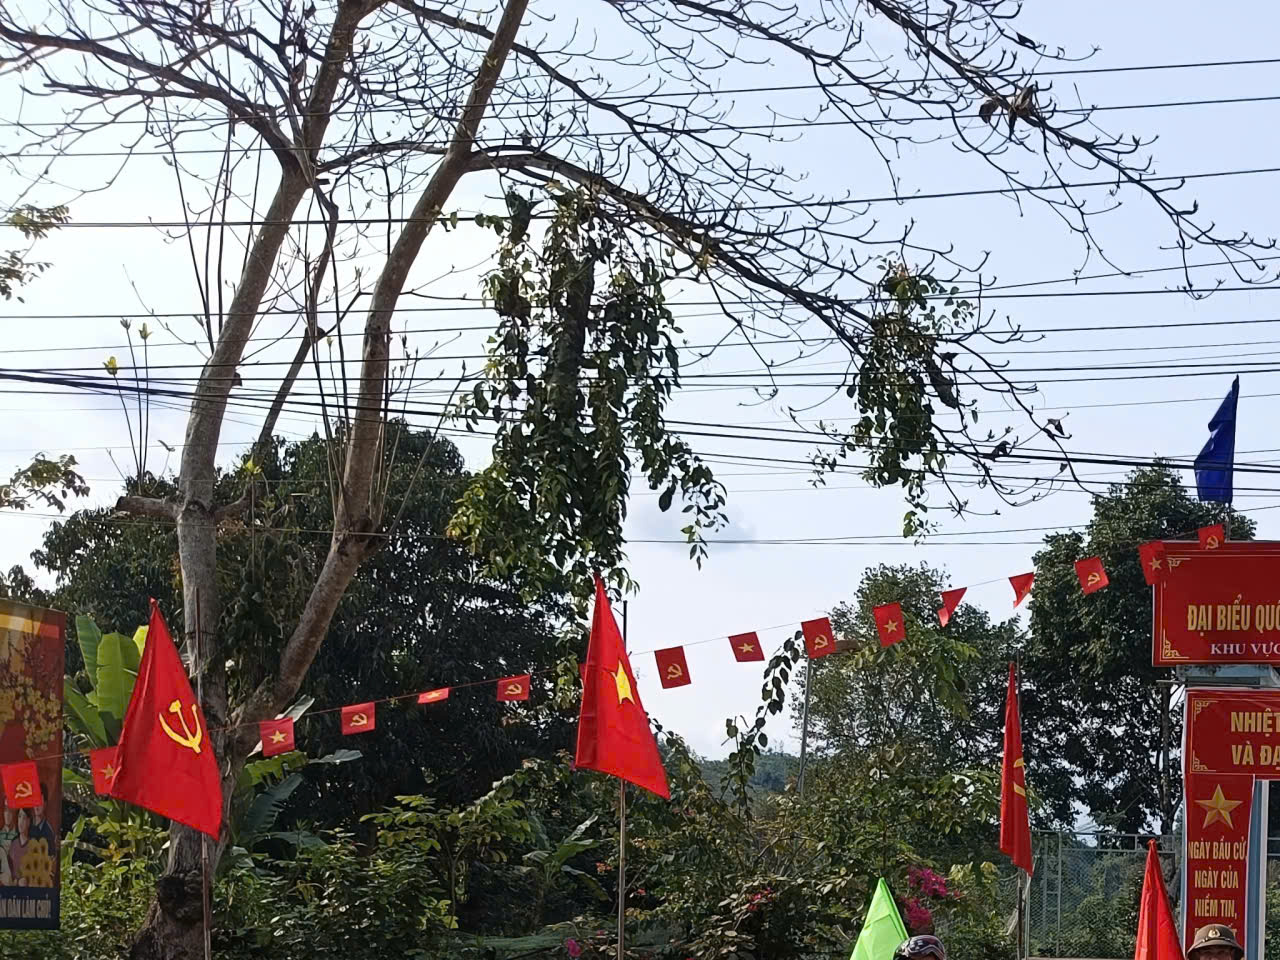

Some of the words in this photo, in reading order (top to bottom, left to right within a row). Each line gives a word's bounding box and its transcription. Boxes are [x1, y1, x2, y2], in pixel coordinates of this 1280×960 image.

[1187, 604, 1212, 636] ĐẠI
[1217, 594, 1250, 631] BIỂU
[1211, 643, 1245, 655] KHU
[1231, 740, 1254, 765] VÀ
[1194, 866, 1219, 889] NGÀY
[1221, 864, 1239, 889] CỦA
[1220, 899, 1237, 920] TIN,
